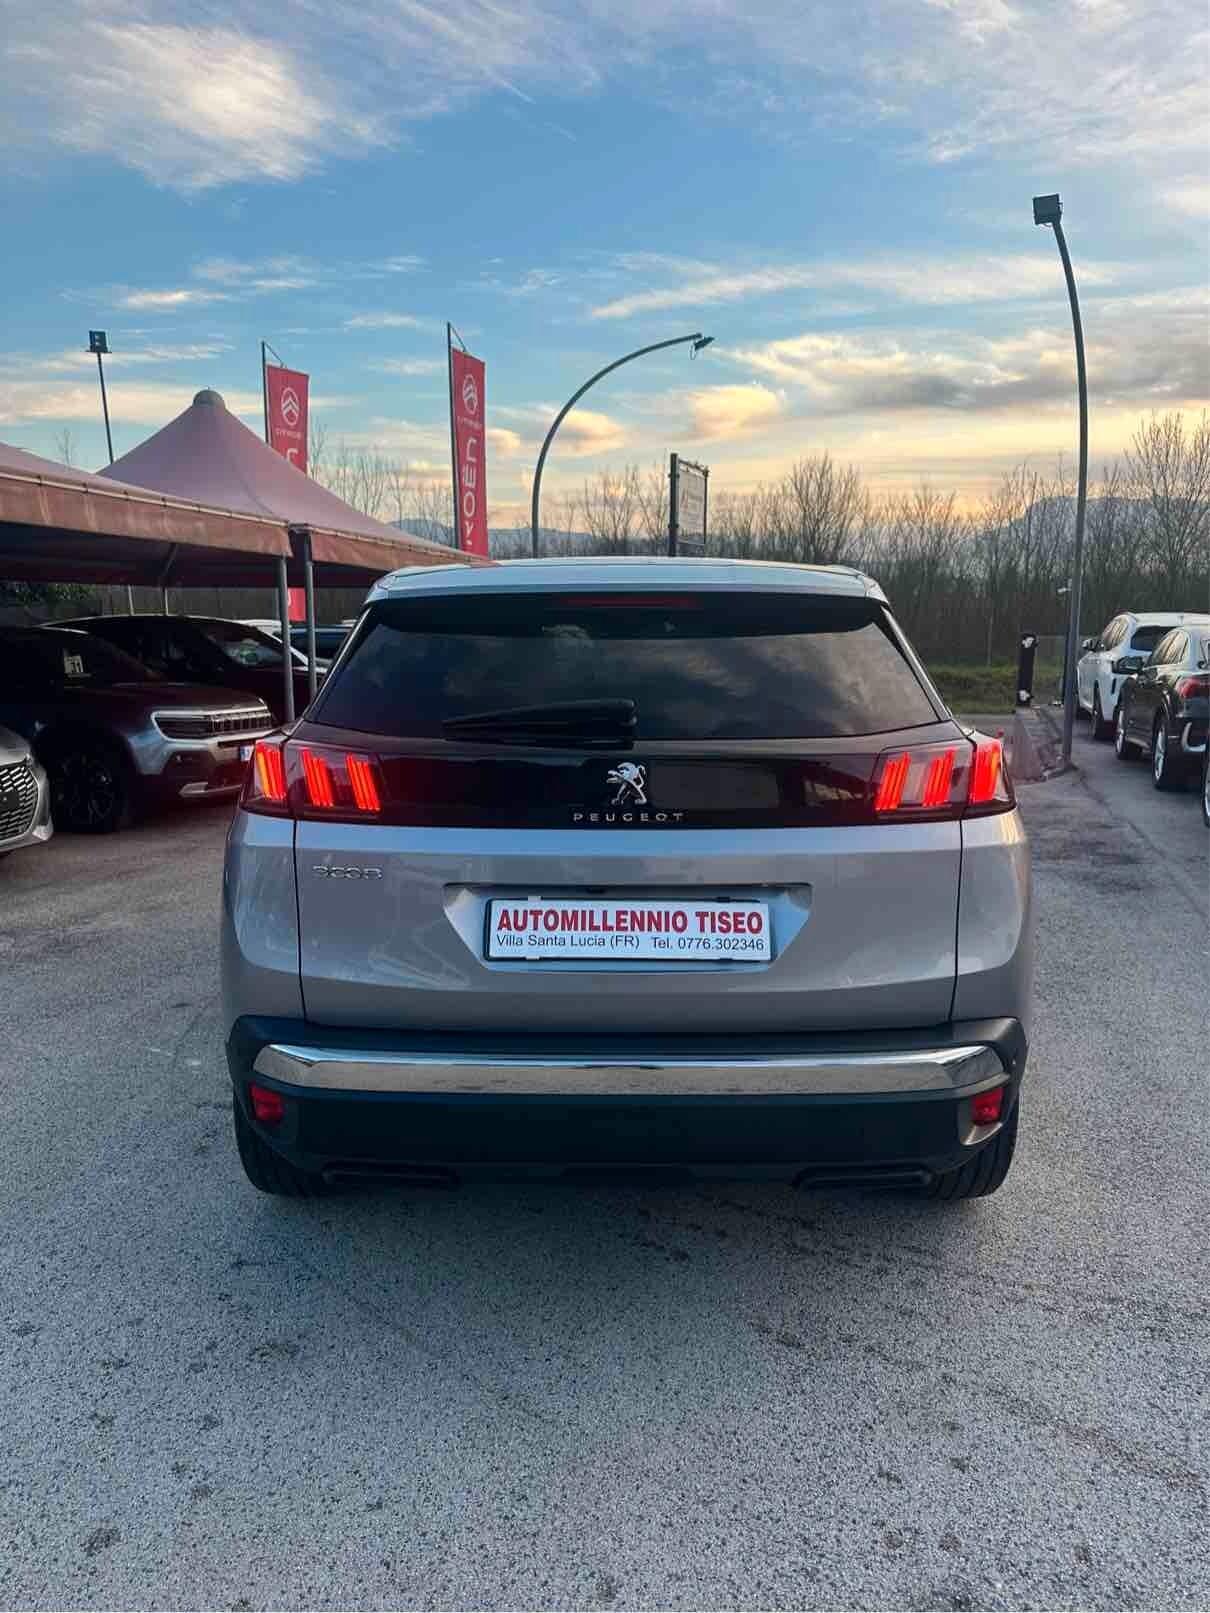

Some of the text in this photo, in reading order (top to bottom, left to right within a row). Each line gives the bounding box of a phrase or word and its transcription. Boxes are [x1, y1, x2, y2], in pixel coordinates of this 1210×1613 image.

[573, 812, 684, 822] PEUGEOT
[497, 909, 763, 934] AUTOMILLENNIO TISEO
[497, 934, 764, 950] Villa Santa Lucia (FR) Tel. 0776.302346
